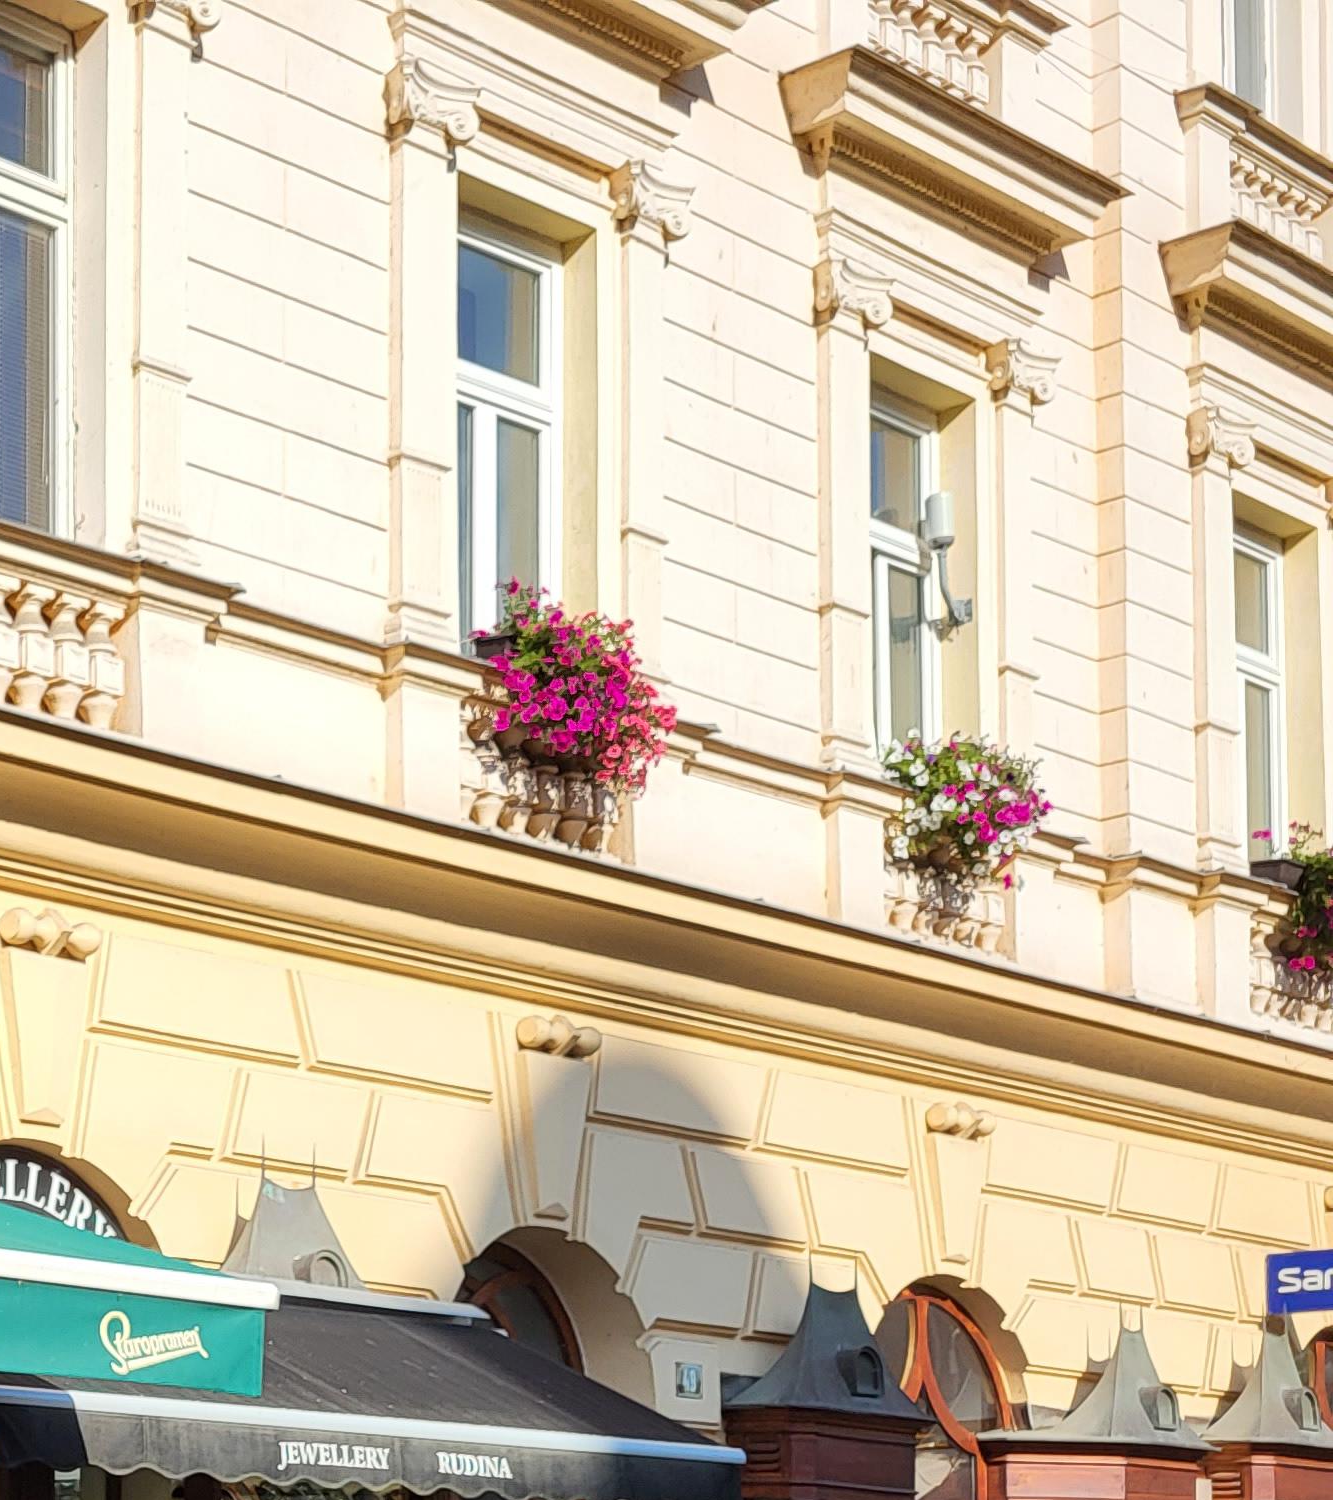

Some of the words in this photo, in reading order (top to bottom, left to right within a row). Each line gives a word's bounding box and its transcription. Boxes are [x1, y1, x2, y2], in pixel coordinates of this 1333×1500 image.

[100, 1310, 209, 1376] Staropramen
[278, 1442, 390, 1470] JEWELLERY
[437, 1452, 513, 1479] RUDINA
